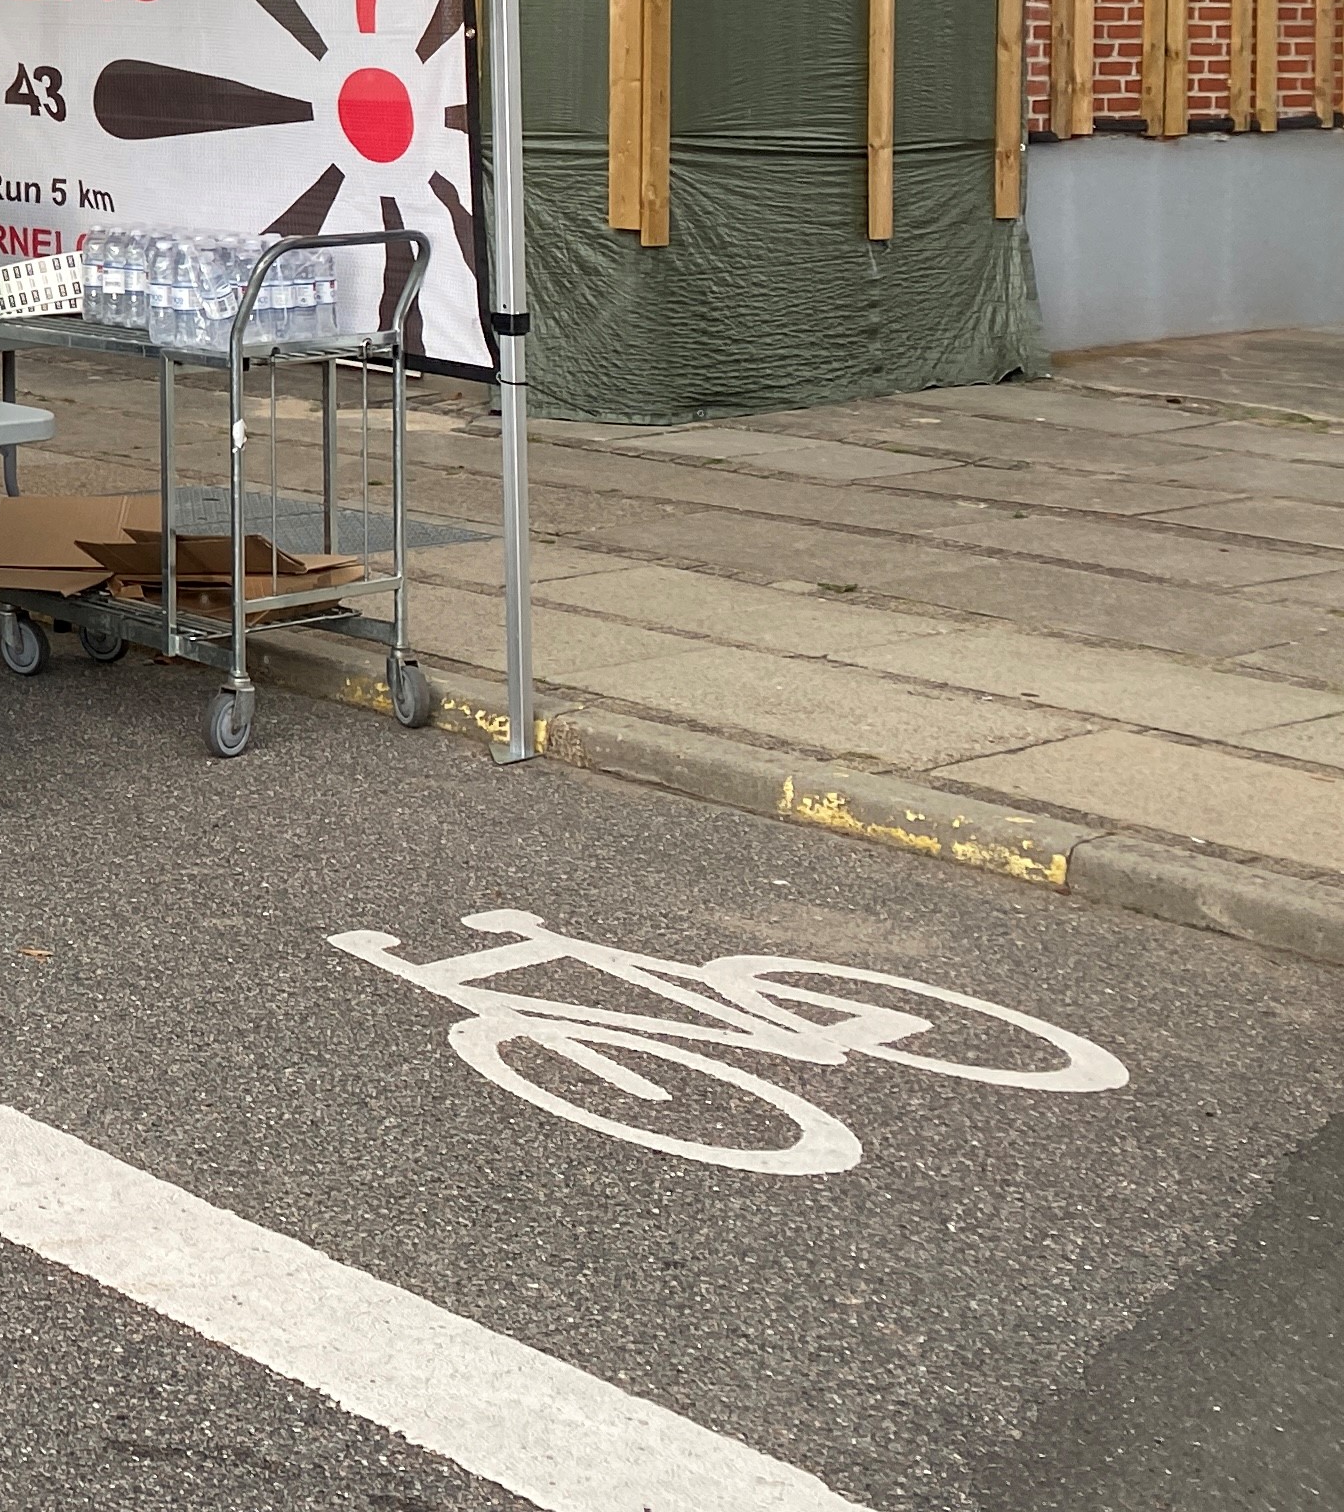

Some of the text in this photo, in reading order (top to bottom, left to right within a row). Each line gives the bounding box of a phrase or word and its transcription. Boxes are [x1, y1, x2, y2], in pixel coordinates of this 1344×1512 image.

[4, 61, 67, 122] 43
[51, 178, 67, 206] 5
[78, 180, 115, 213] km
